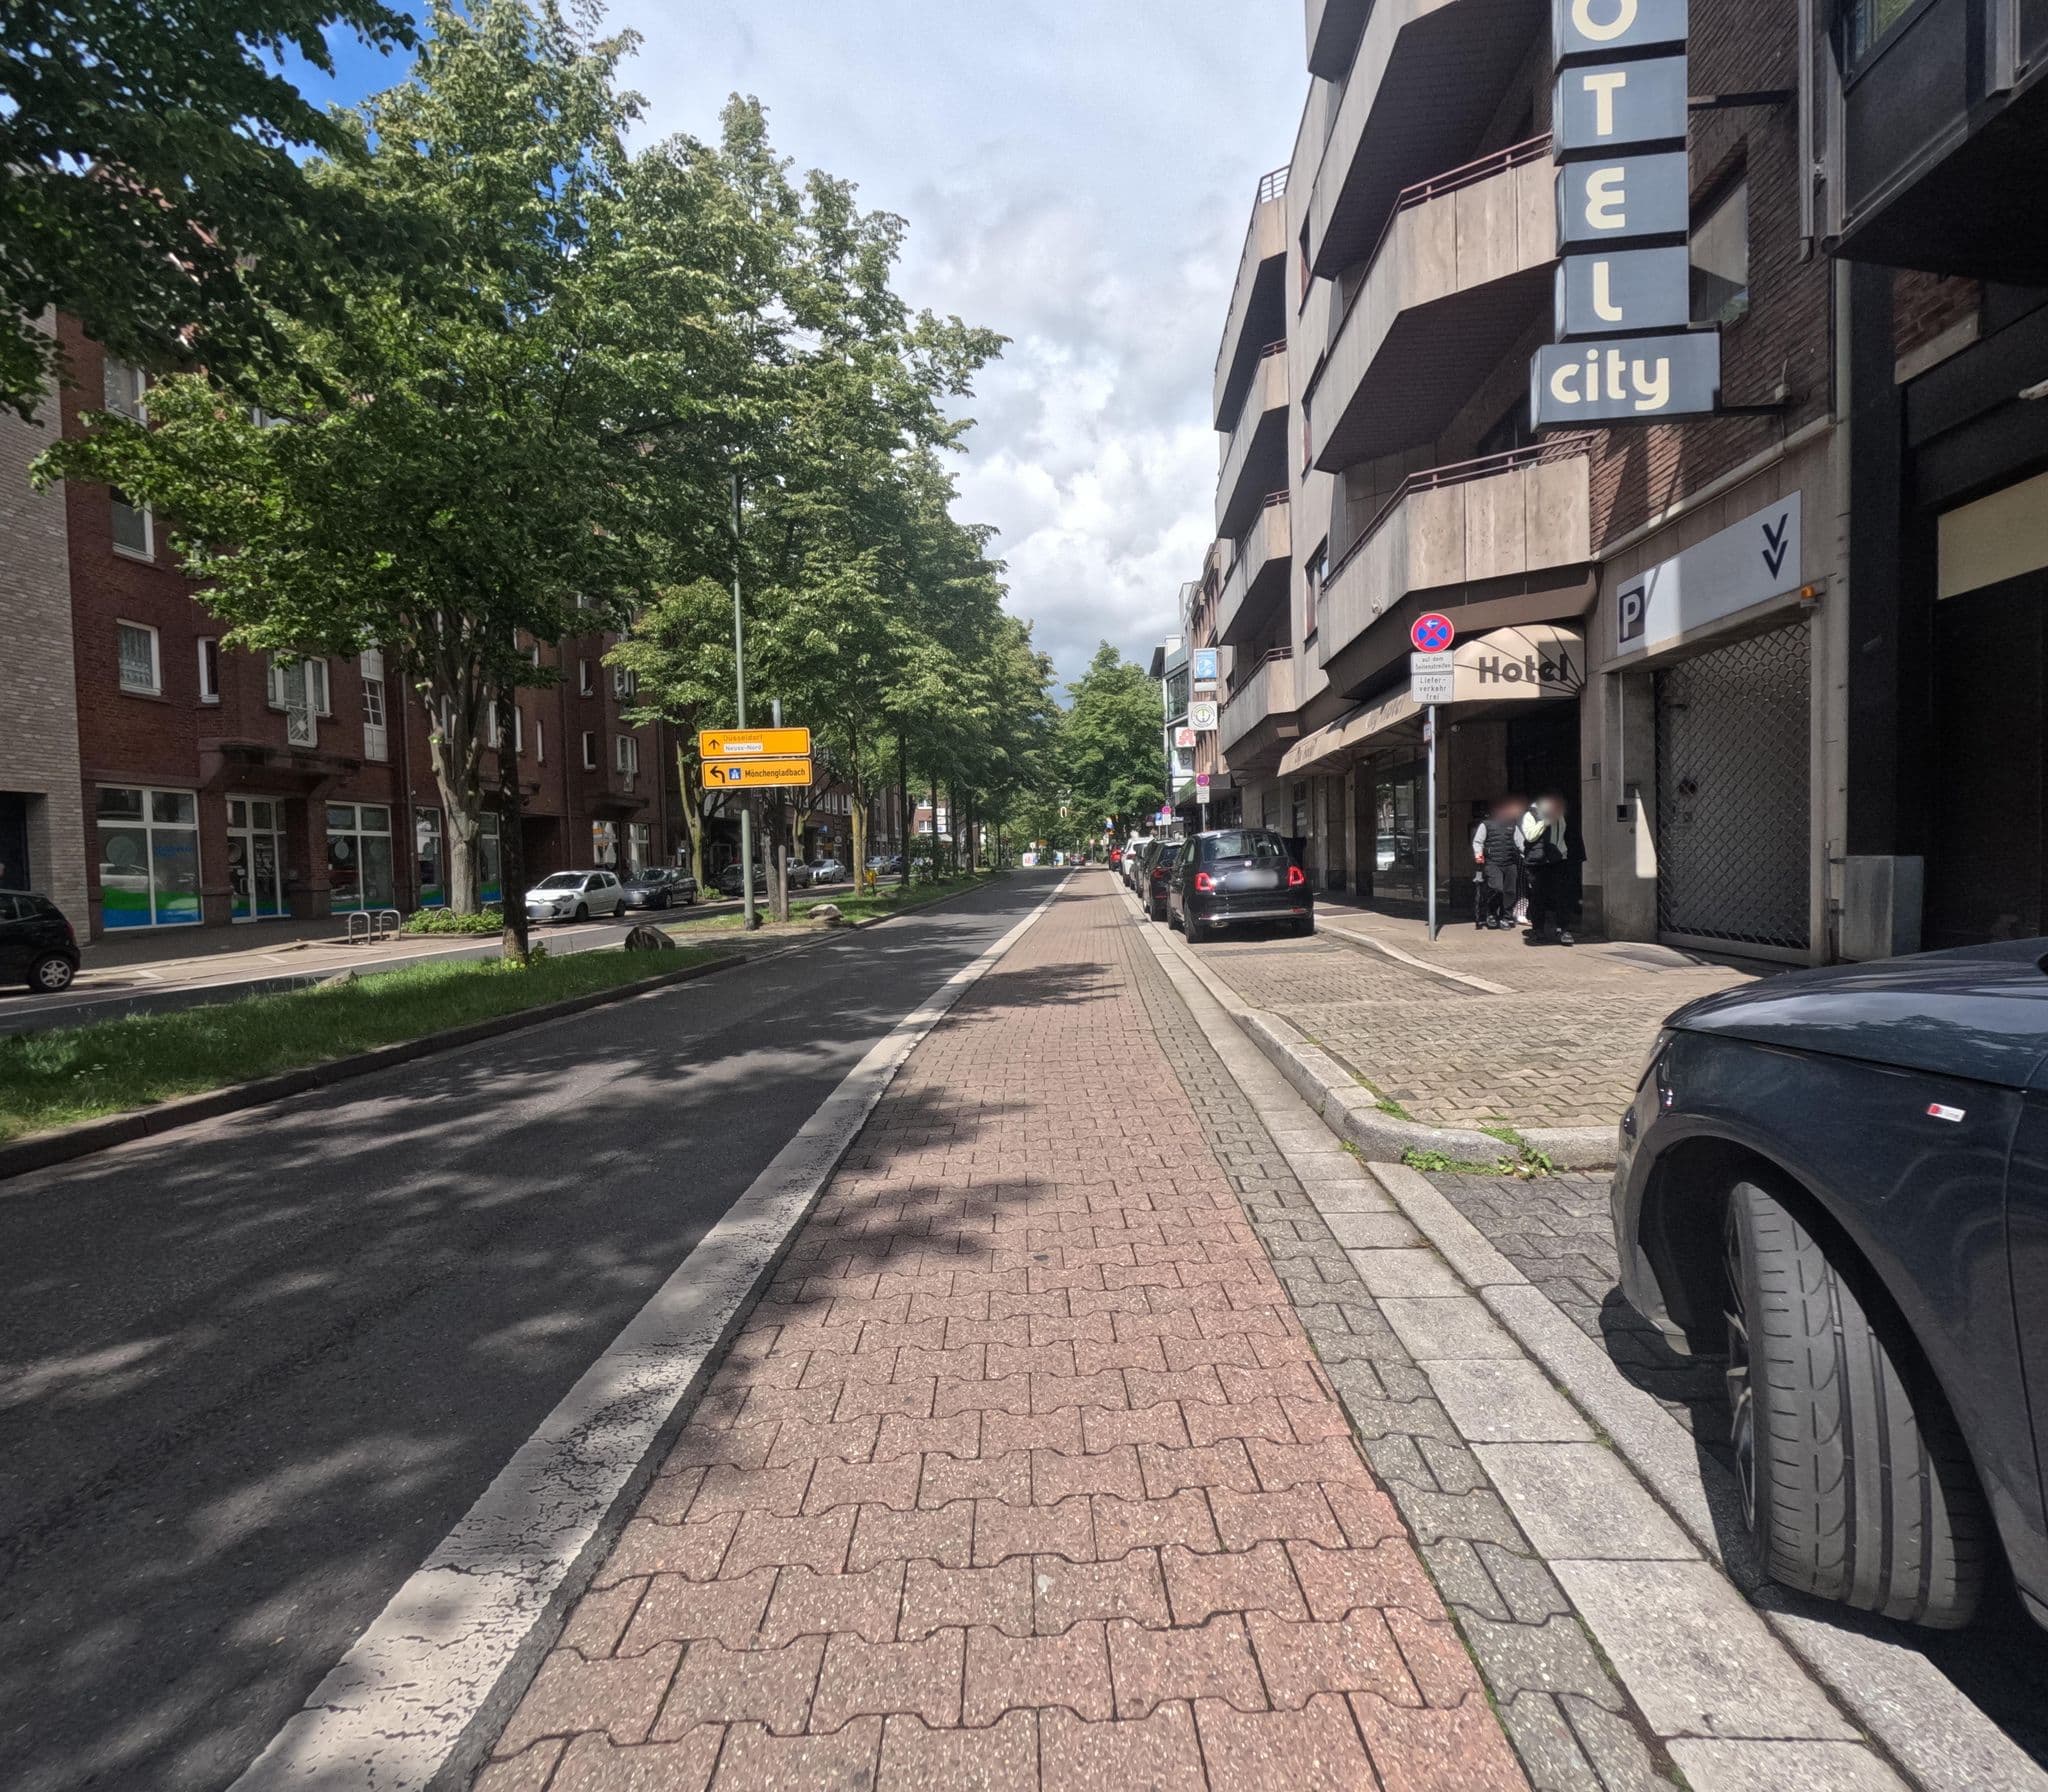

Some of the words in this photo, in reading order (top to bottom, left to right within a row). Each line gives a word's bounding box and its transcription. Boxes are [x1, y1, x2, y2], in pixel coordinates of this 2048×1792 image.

[1550, 349, 1670, 411] city
[1623, 593, 1641, 639] P
[1420, 676, 1447, 684] Liefer-
[1479, 653, 1568, 684] Hotel
[744, 768, 806, 778] Mönchengladbach
